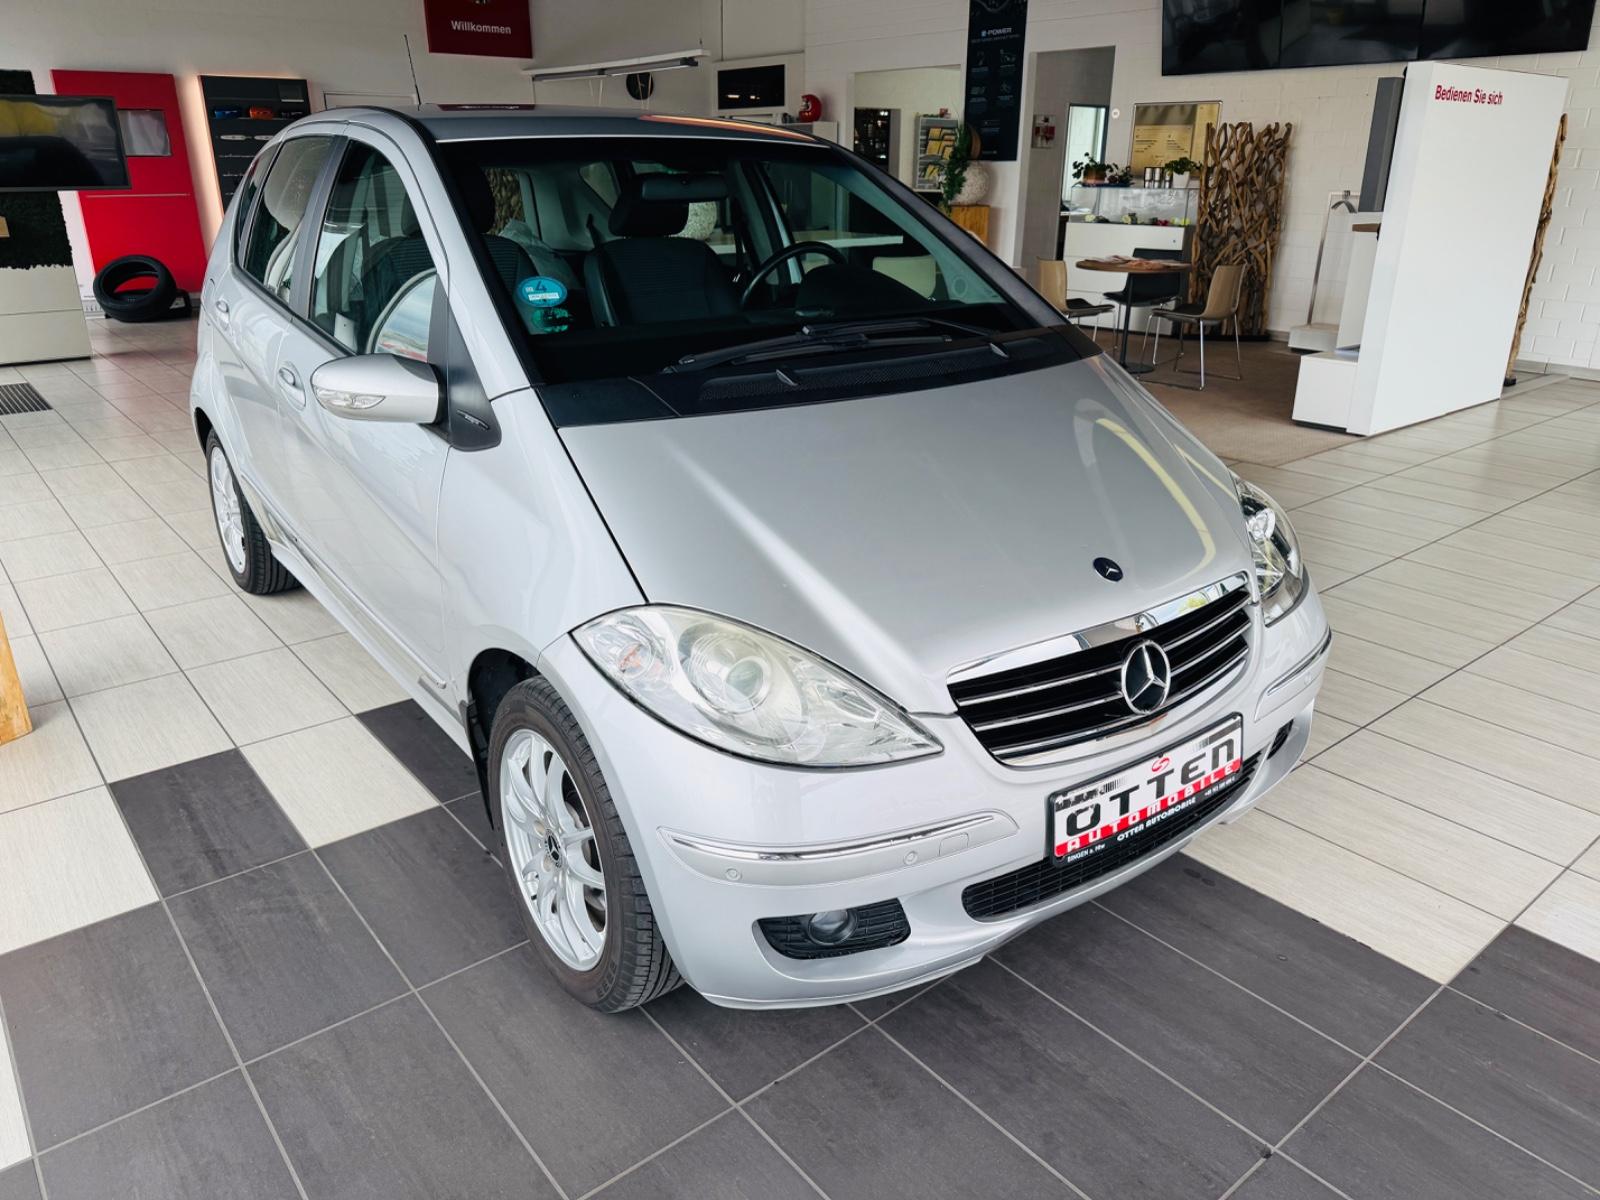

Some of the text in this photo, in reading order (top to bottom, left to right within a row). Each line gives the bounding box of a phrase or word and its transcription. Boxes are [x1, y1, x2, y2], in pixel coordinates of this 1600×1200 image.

[451, 20, 512, 35] Willkommen
[1435, 84, 1503, 105] Bedienen Sie sich
[1066, 738, 1235, 837] OTTEN
[1067, 764, 1234, 853] AUTOMOBILE
